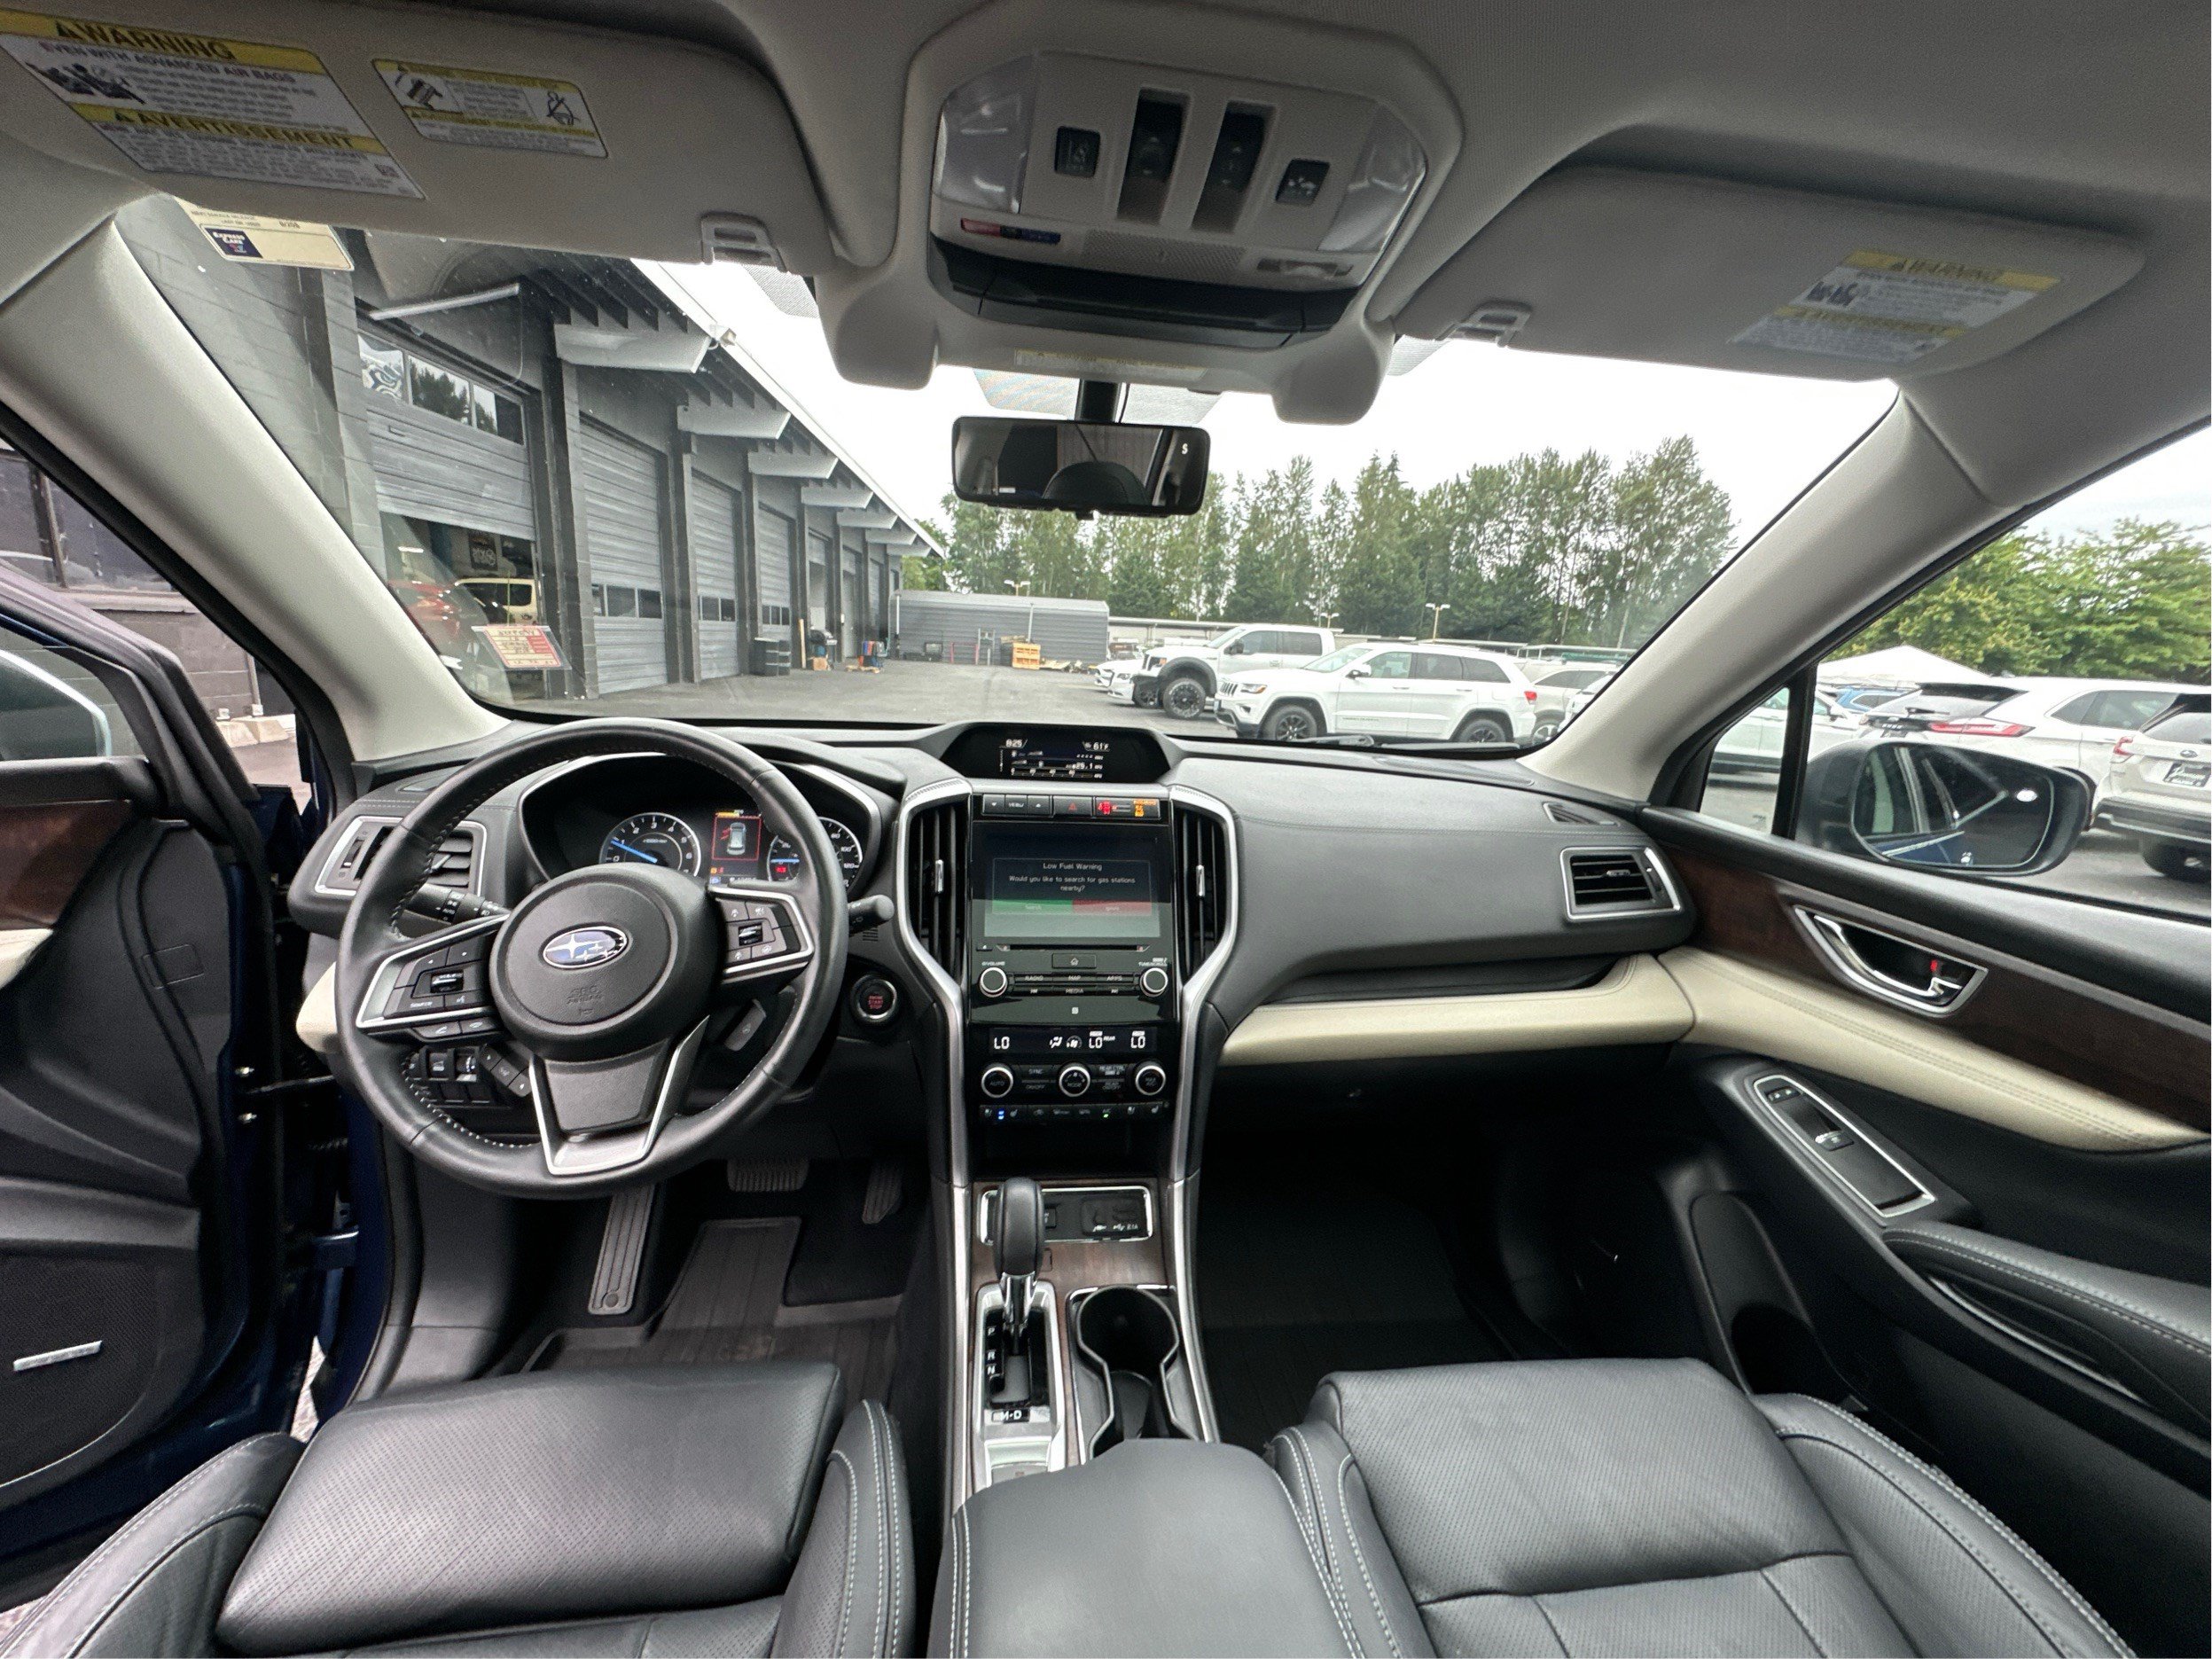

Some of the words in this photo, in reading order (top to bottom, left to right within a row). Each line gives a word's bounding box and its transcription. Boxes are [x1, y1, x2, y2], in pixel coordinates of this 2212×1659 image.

[73, 22, 237, 59] WARNING
[137, 112, 354, 149] AVERTISSEMENT
[1181, 442, 1189, 455] S
[1075, 863, 1103, 872] Warning
[993, 1036, 1010, 1050] LO
